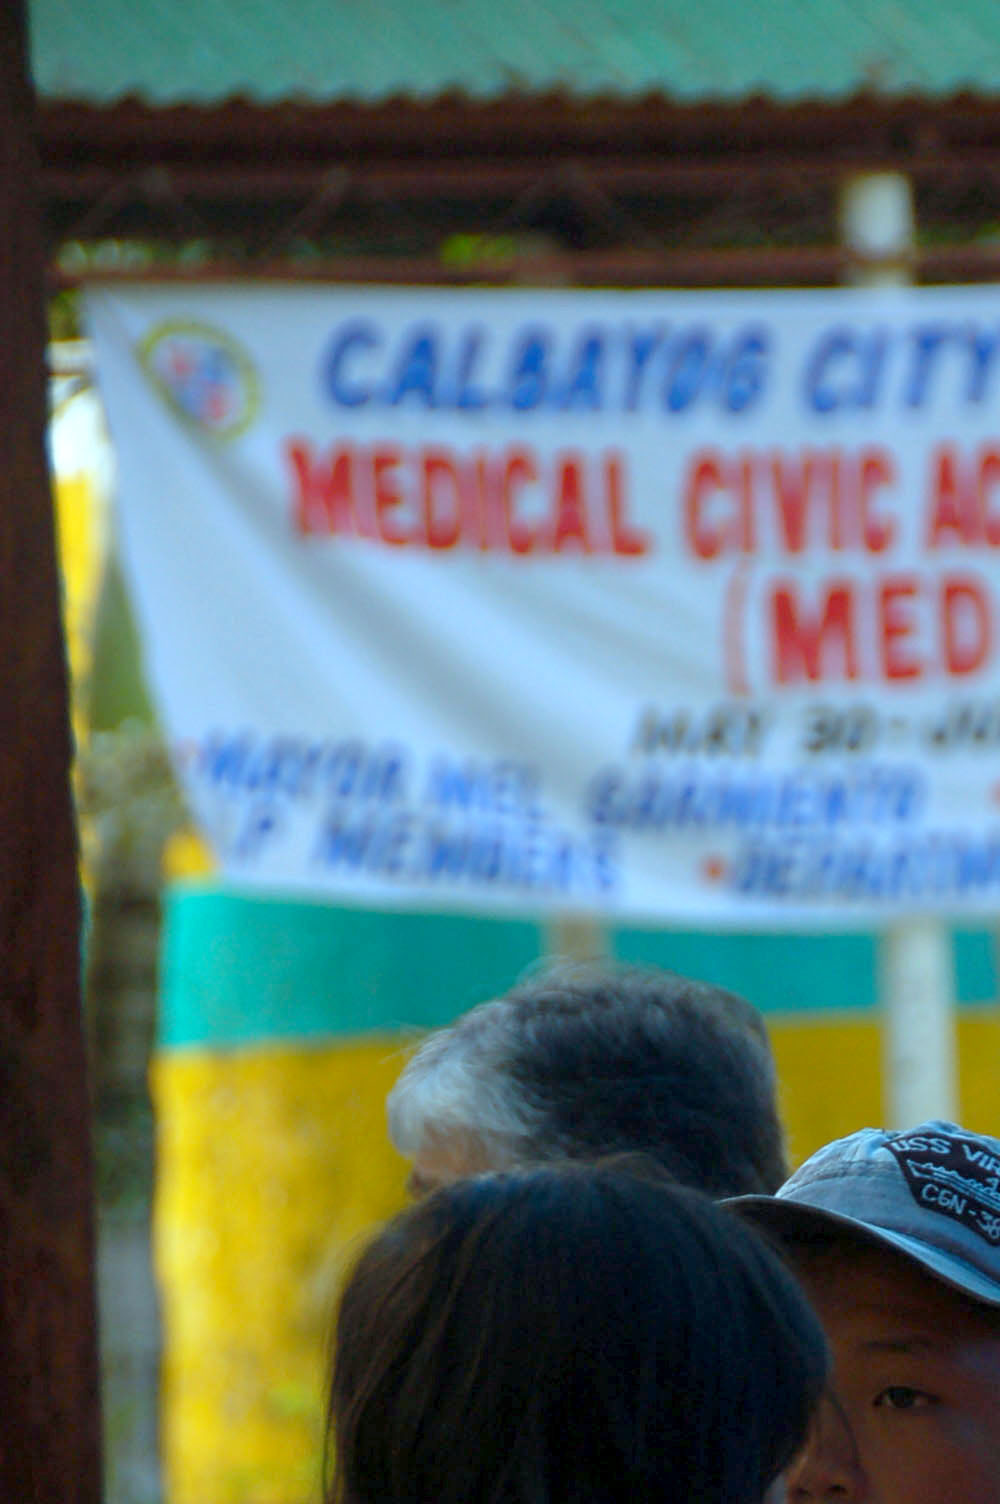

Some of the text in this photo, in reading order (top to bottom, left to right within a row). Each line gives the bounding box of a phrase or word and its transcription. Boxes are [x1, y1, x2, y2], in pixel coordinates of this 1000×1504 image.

[320, 312, 772, 420] CALBAYOG
[284, 434, 651, 560] MEDICAL
[684, 442, 897, 563] CIVIC
[632, 705, 769, 757] MAY
[892, 1136, 950, 1154] USS
